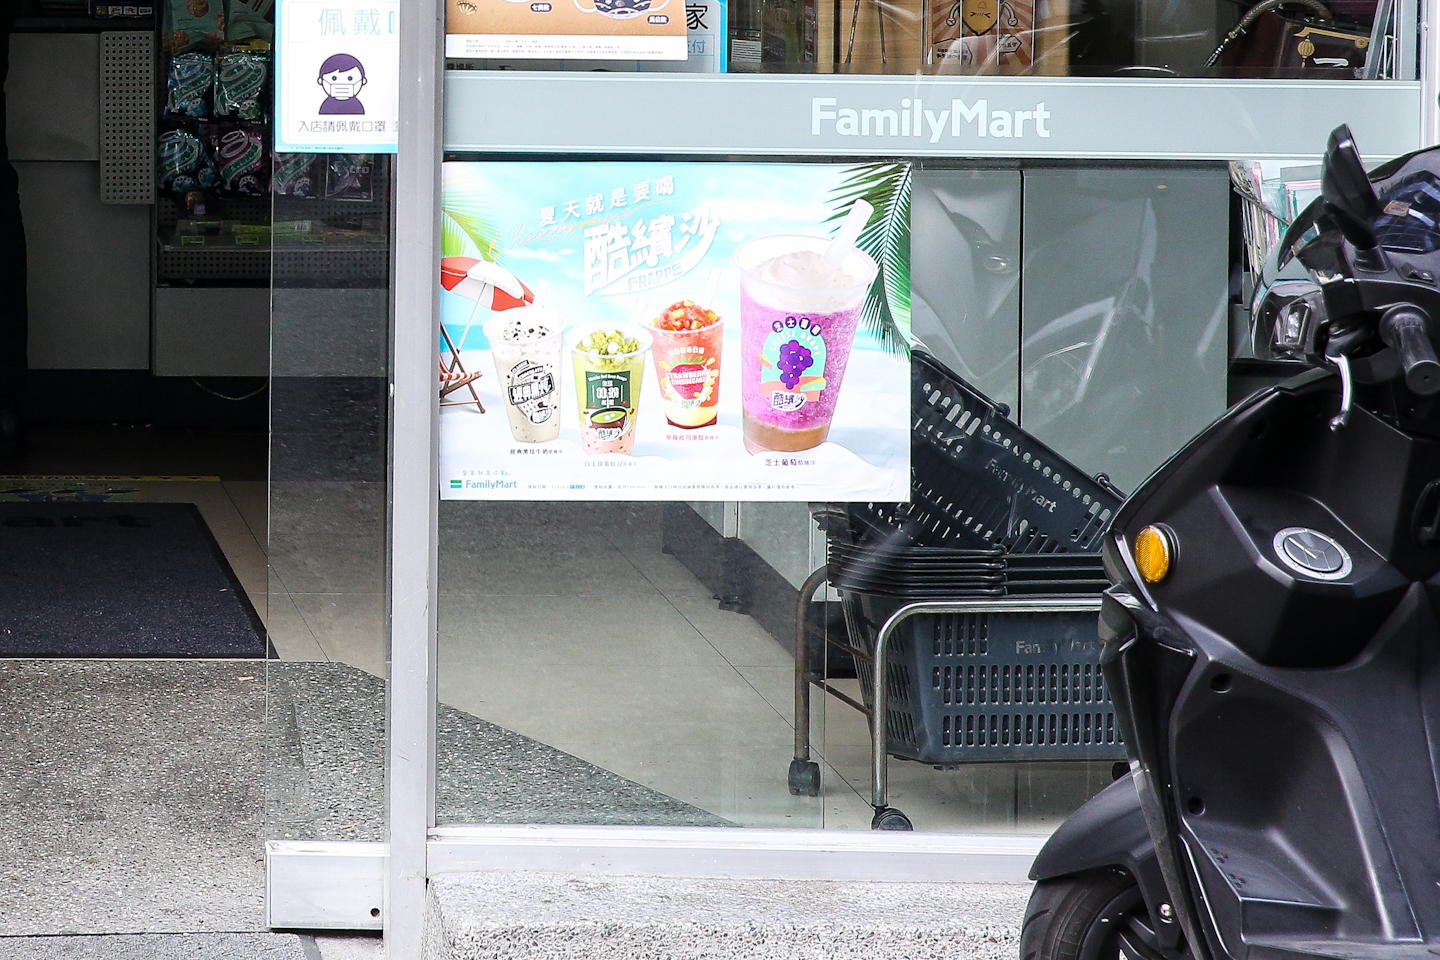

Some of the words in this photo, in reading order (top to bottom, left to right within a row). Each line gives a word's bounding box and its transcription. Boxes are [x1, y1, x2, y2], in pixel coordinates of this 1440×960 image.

[318, 8, 395, 36] 佩戴
[686, 3, 708, 30] 家
[298, 120, 386, 133] 入店請佩戴口罩
[811, 97, 1051, 144] FamilyMart
[538, 175, 675, 228] 夏天就是要喝
[583, 206, 720, 297] 酷繽沙
[627, 262, 683, 291] FRAPPE
[769, 330, 796, 352] CHEESE
[800, 331, 821, 356] GRAPE
[466, 479, 517, 490] FamilyMart
